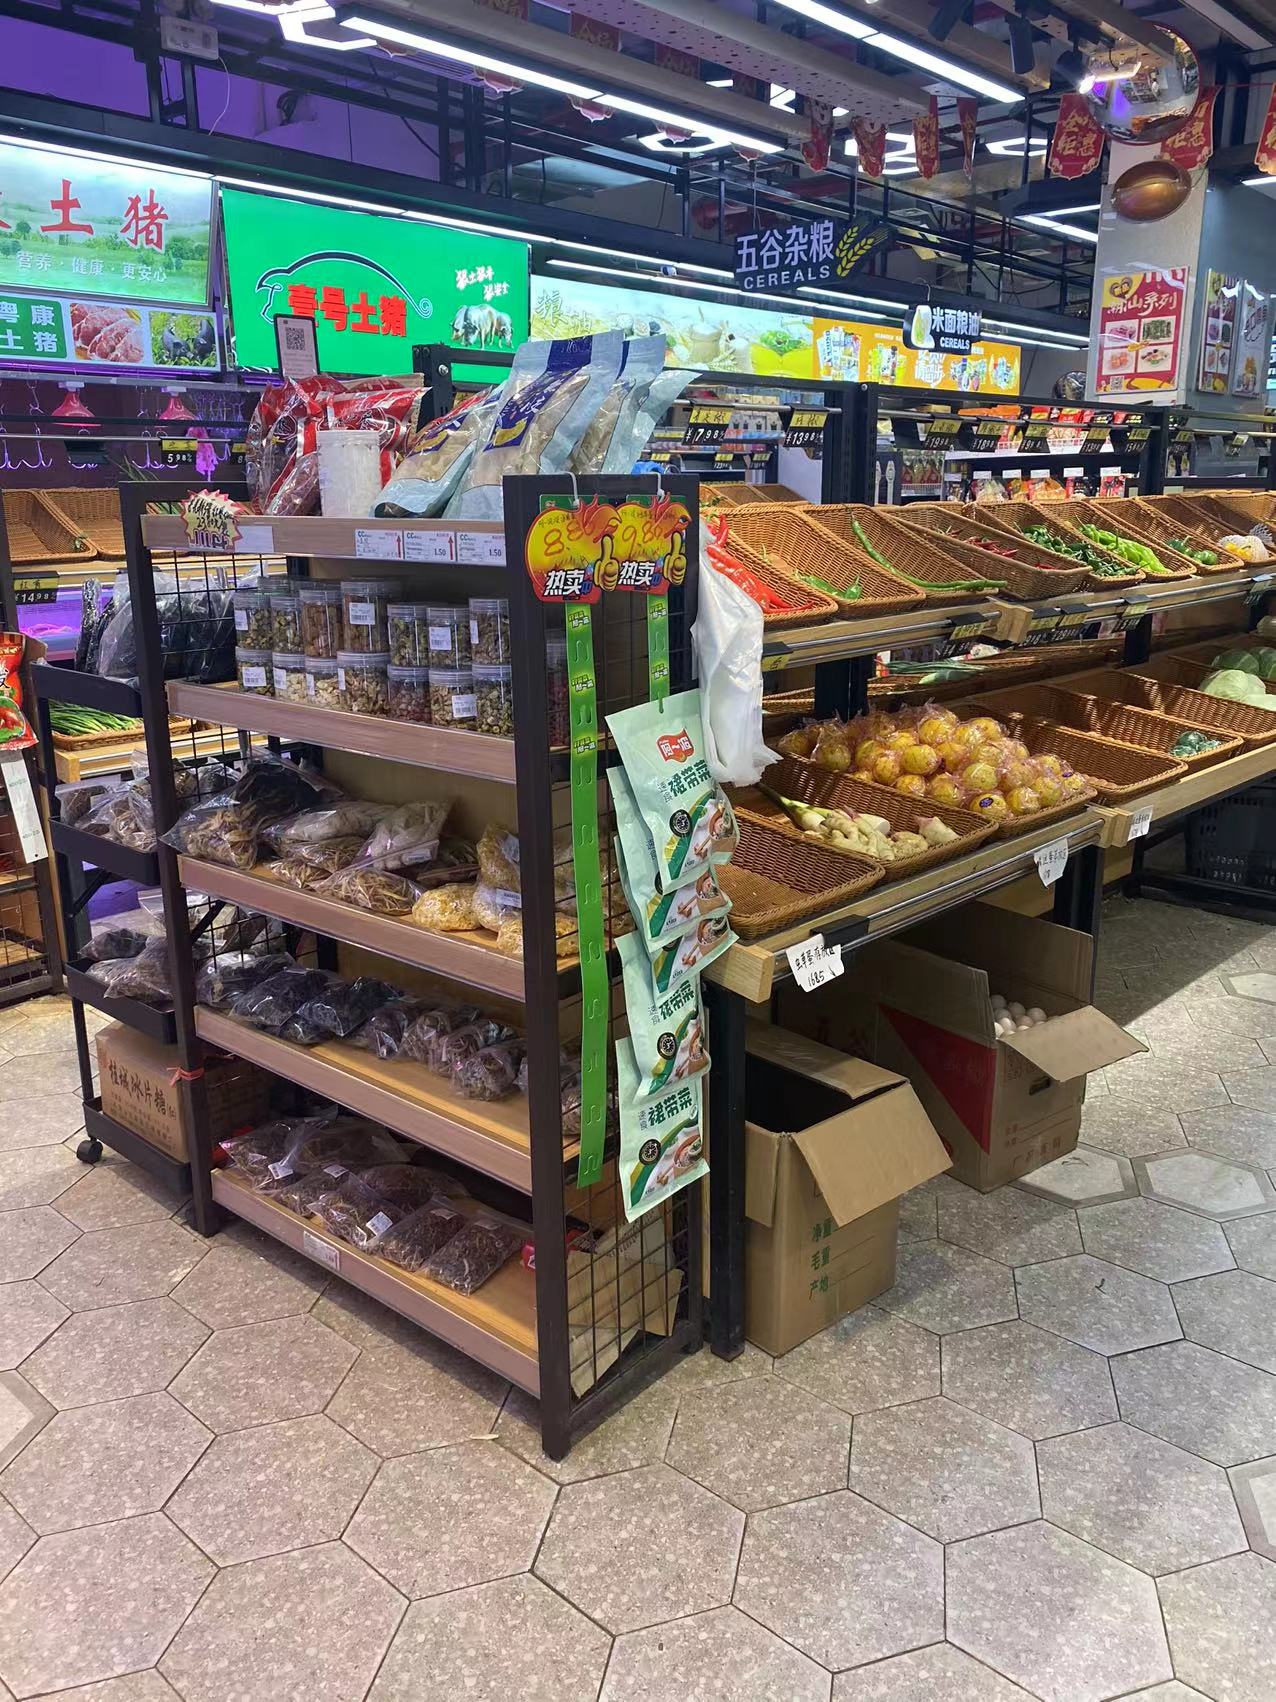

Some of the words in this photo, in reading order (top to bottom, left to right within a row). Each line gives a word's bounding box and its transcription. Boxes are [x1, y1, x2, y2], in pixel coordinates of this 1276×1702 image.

[0, 178, 168, 250] 土猪
[736, 220, 835, 274] 五谷杂粮
[743, 264, 831, 290] CEREALS
[287, 283, 407, 338] 壹号土猪
[932, 307, 981, 336] 米面粮油
[939, 336, 971, 350] CEREALS
[543, 569, 585, 596] 热卖
[618, 560, 656, 586] 热卖
